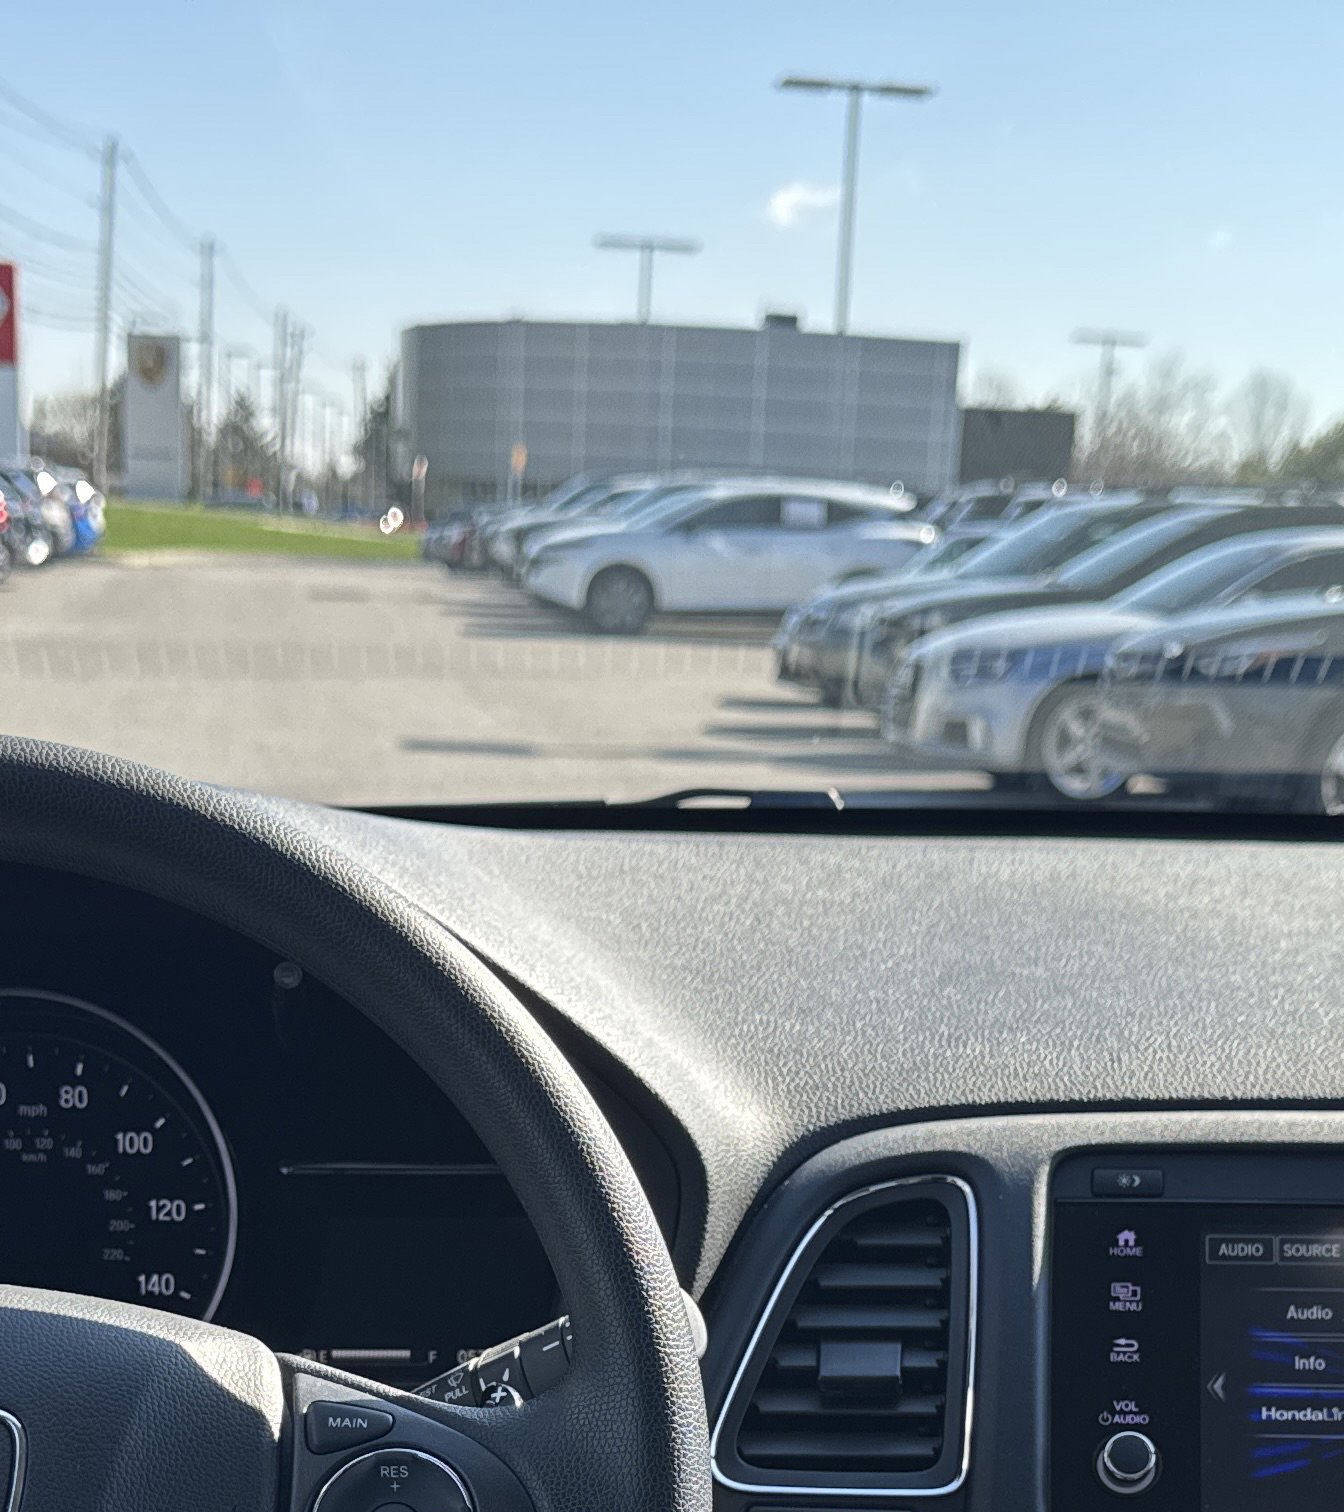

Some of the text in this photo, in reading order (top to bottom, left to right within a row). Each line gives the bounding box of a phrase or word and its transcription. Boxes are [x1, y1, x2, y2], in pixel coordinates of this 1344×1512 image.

[59, 1085, 89, 1109] 80
[18, 1103, 47, 1118] mph
[115, 1131, 154, 1155] 100
[149, 1199, 187, 1223] 120
[1109, 1246, 1143, 1257] HOME
[1218, 1243, 1264, 1257] AUDIO
[1283, 1243, 1341, 1258] SOURCE
[138, 1274, 176, 1297] 140
[1109, 1301, 1142, 1312] MENU
[1285, 1304, 1333, 1320] Audio
[1109, 1352, 1141, 1363] BACK
[1294, 1355, 1326, 1371] Info
[444, 1385, 469, 1402] PULL
[1113, 1400, 1139, 1412] VOL
[328, 1415, 368, 1430] MAIN
[1112, 1414, 1149, 1425] AUDIO
[380, 1465, 409, 1478] RES
